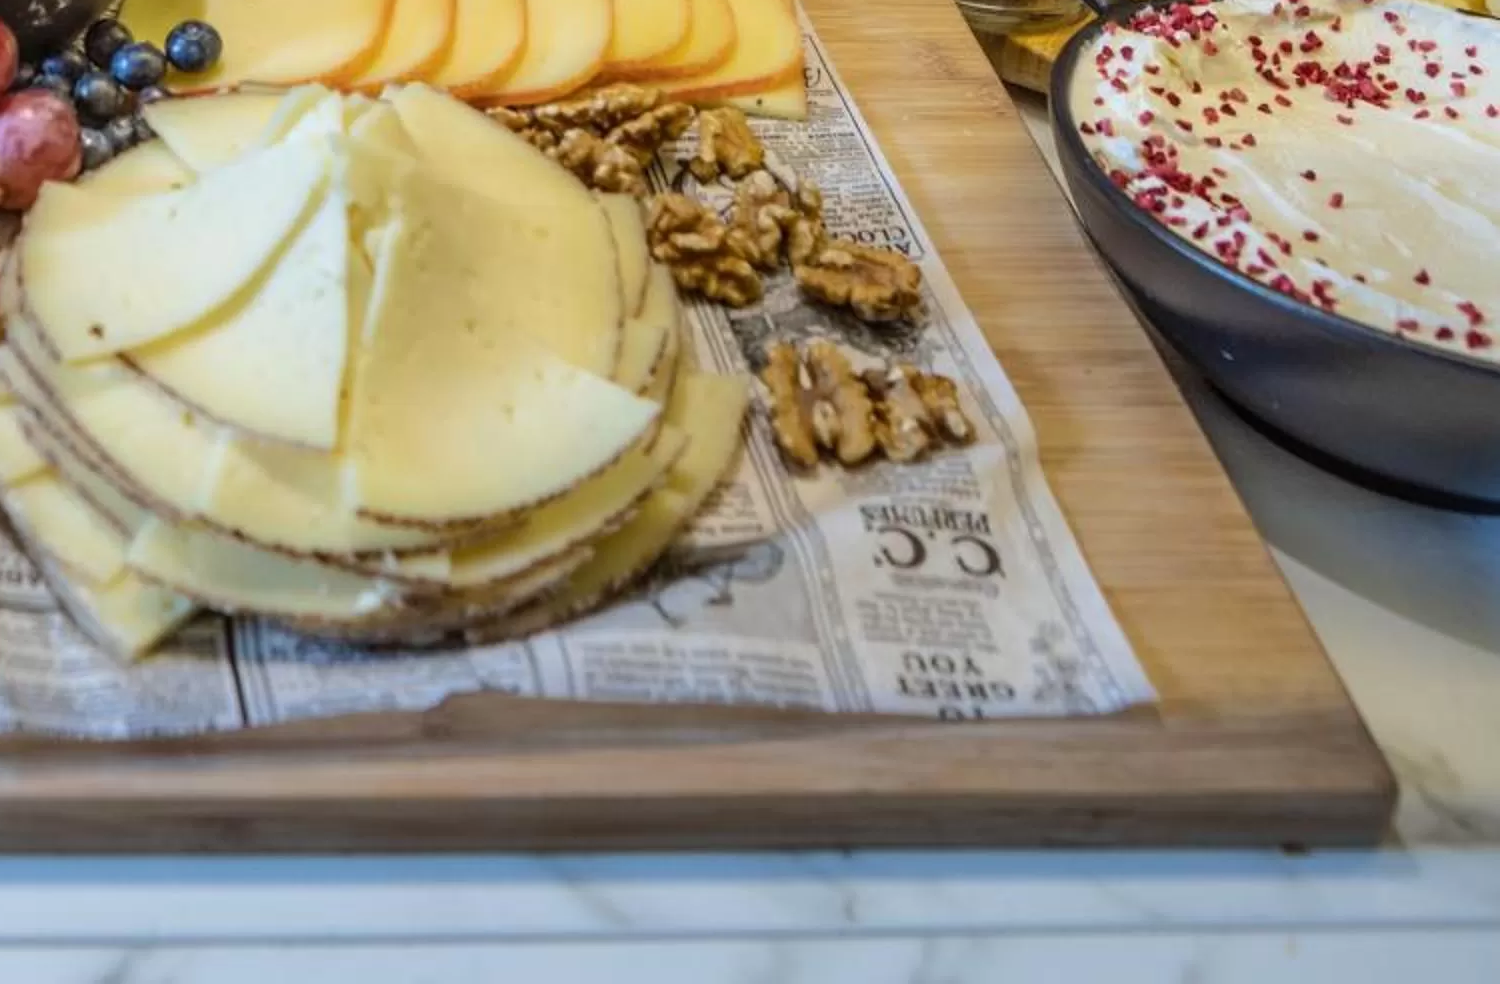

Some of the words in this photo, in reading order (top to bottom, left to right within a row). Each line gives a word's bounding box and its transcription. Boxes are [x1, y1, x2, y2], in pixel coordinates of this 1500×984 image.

[859, 505, 990, 535] PERFUMES
[903, 653, 982, 675] YOU
[897, 676, 1015, 700] GREET
